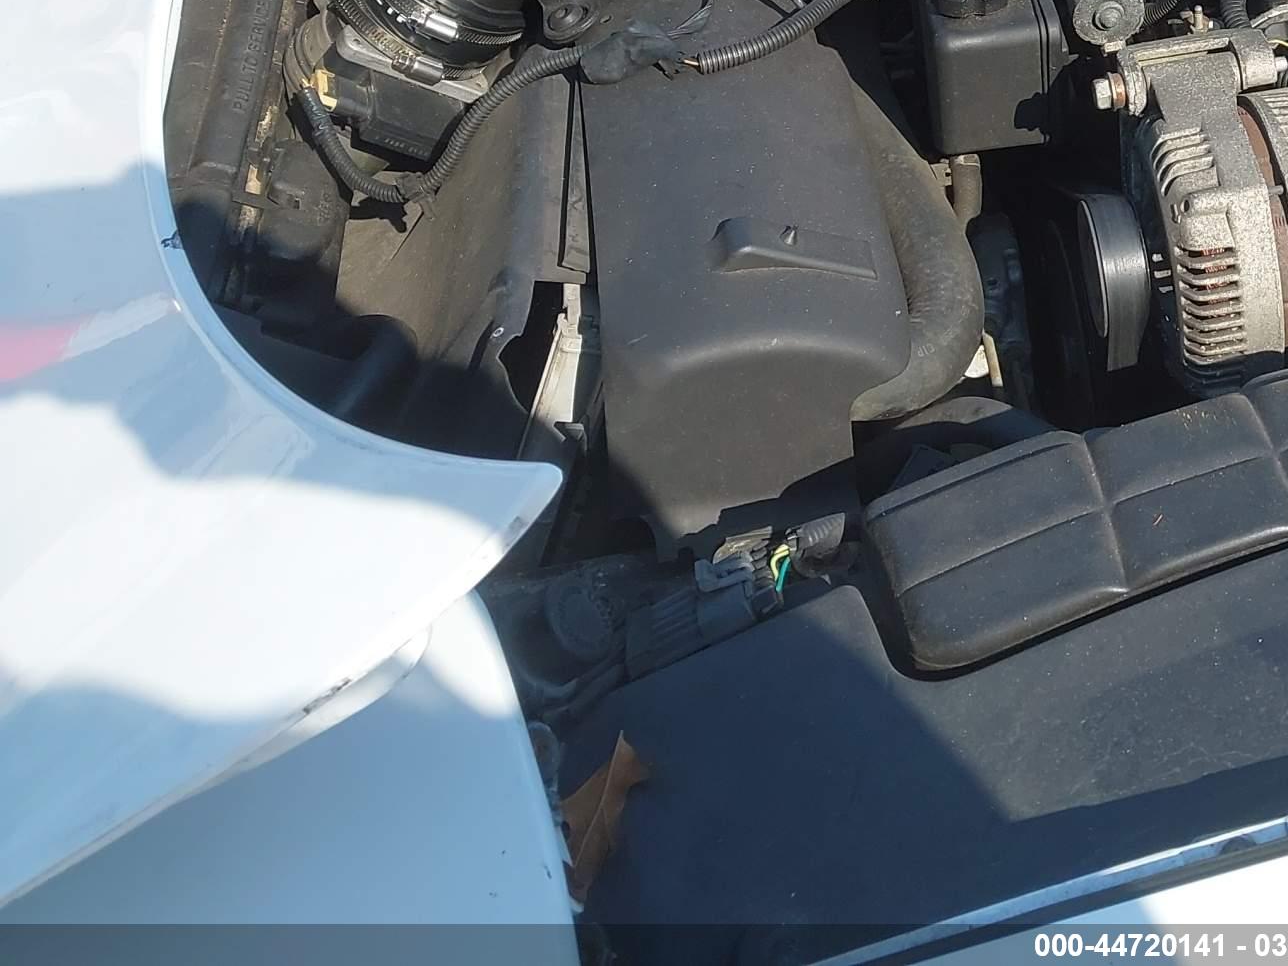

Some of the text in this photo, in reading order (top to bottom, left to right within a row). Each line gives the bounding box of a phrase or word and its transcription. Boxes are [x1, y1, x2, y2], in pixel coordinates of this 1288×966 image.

[246, 0, 271, 53] SERVICE
[242, 56, 258, 74] TO
[231, 76, 255, 114] PULL
